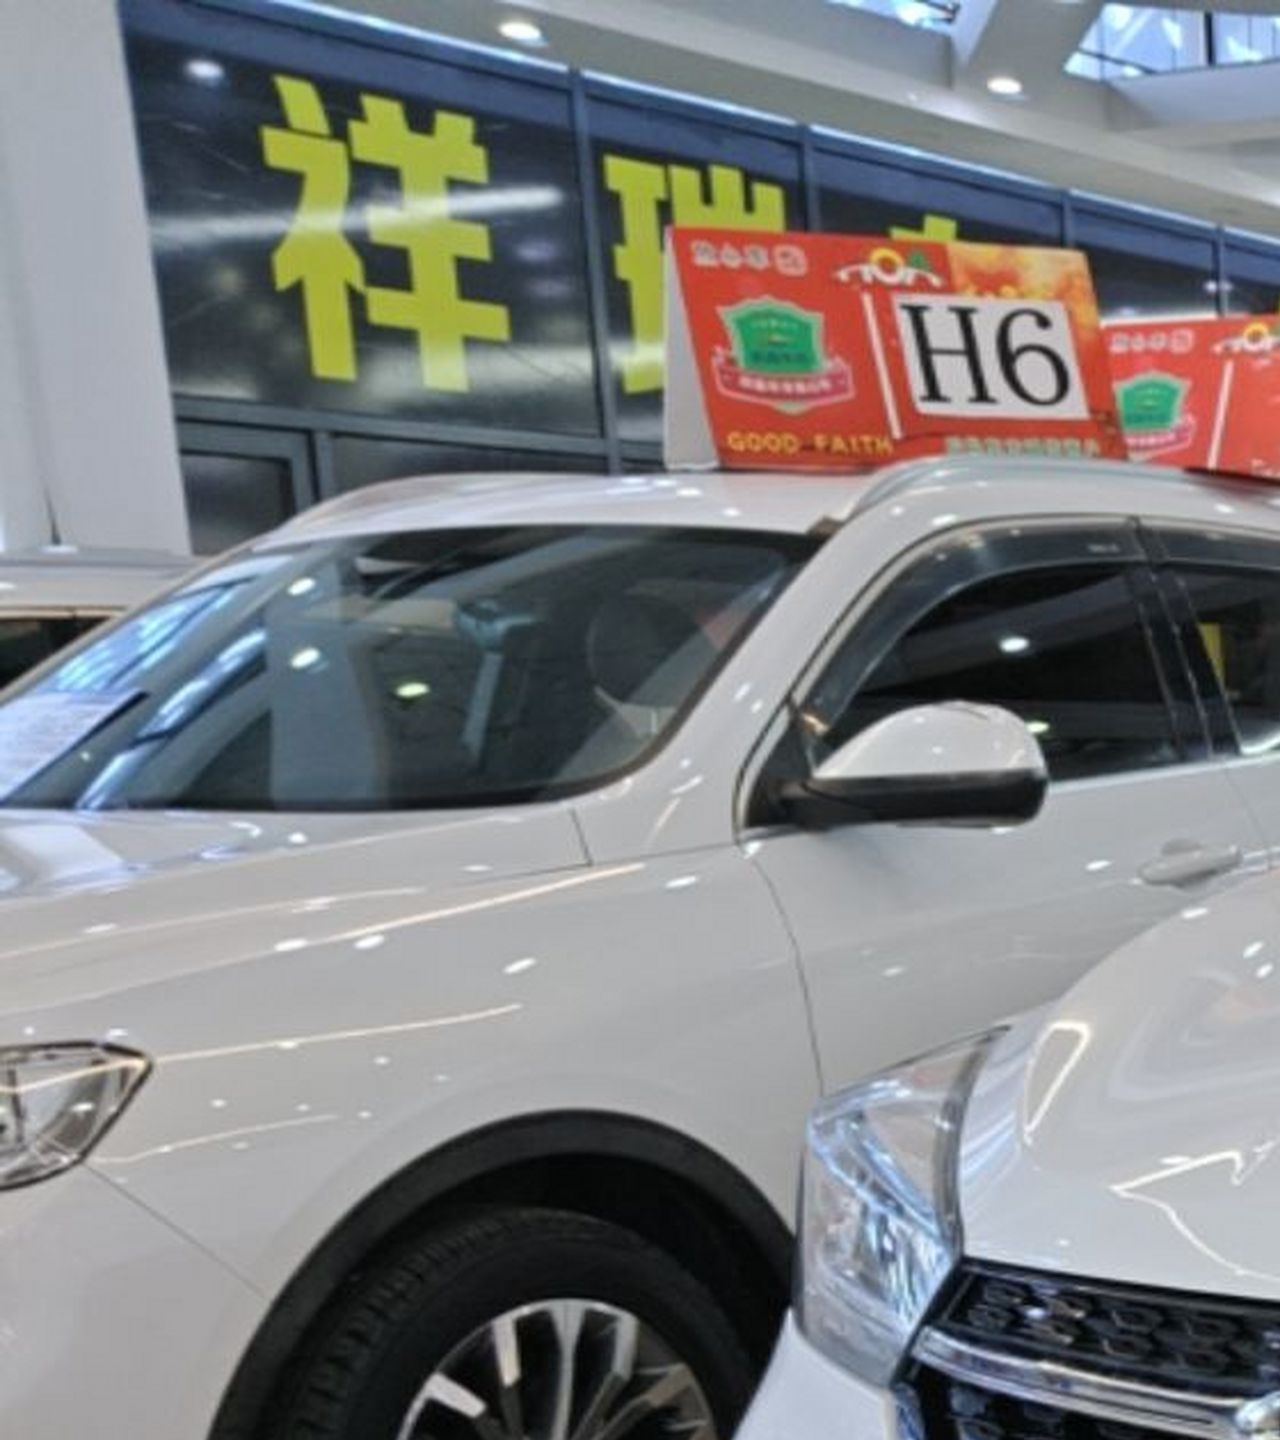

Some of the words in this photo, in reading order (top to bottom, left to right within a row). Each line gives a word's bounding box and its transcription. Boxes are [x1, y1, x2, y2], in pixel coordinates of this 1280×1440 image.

[261, 74, 956, 393] 祥瑞
[900, 304, 1070, 406] H6
[728, 431, 798, 455] GOOD
[814, 433, 894, 456] FAITH
